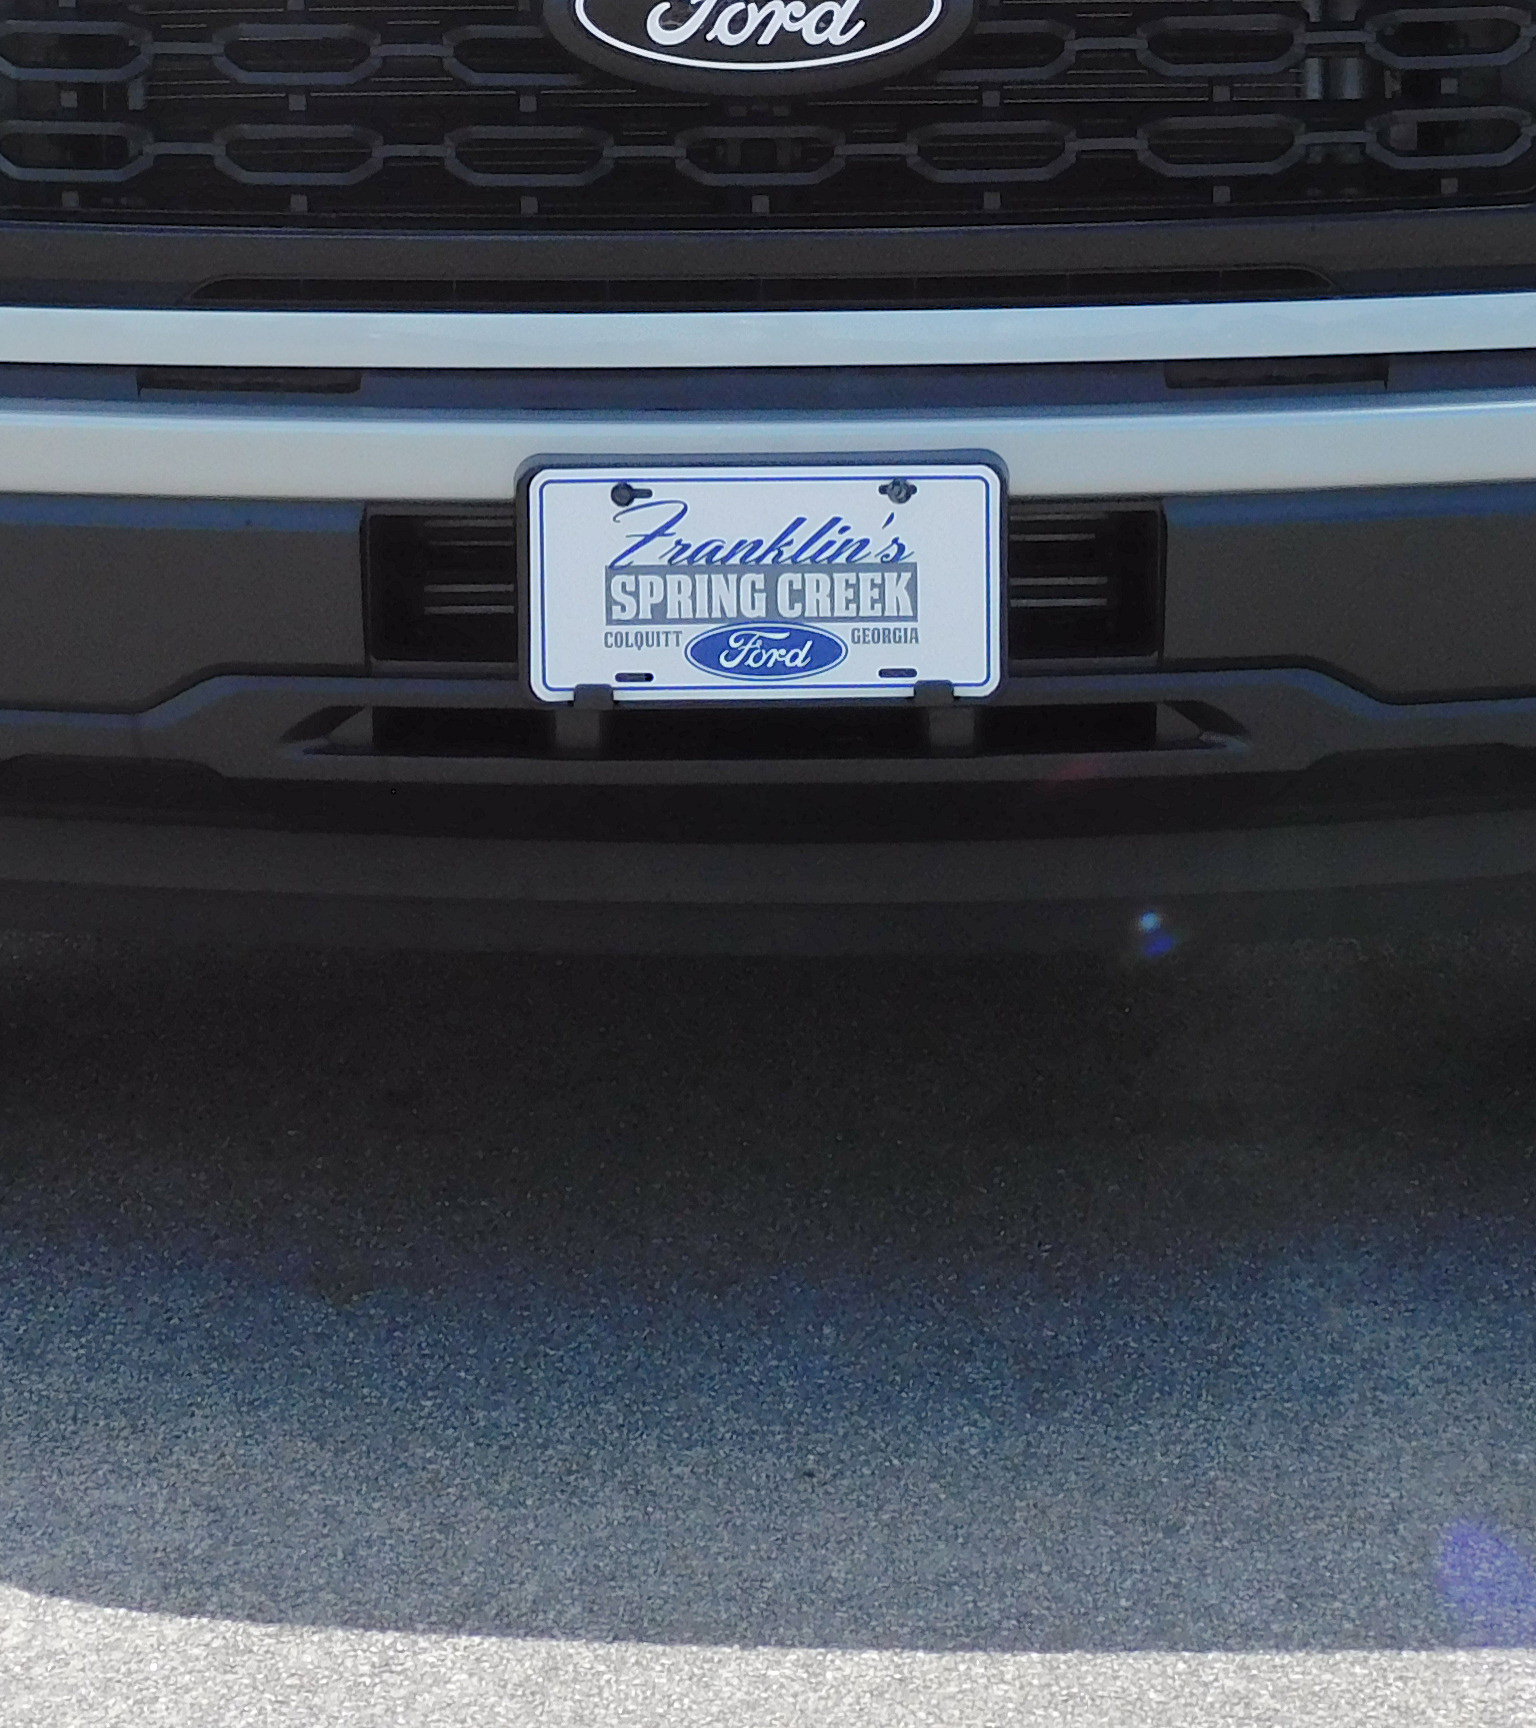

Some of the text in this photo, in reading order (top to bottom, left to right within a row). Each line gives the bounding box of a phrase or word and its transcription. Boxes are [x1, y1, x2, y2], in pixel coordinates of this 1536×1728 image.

[610, 500, 914, 568] Franklin's
[610, 572, 913, 621] SPRING CREEK
[604, 630, 683, 649] COLQUITT
[719, 630, 812, 668] Ford
[850, 627, 920, 645] GEORGIA
